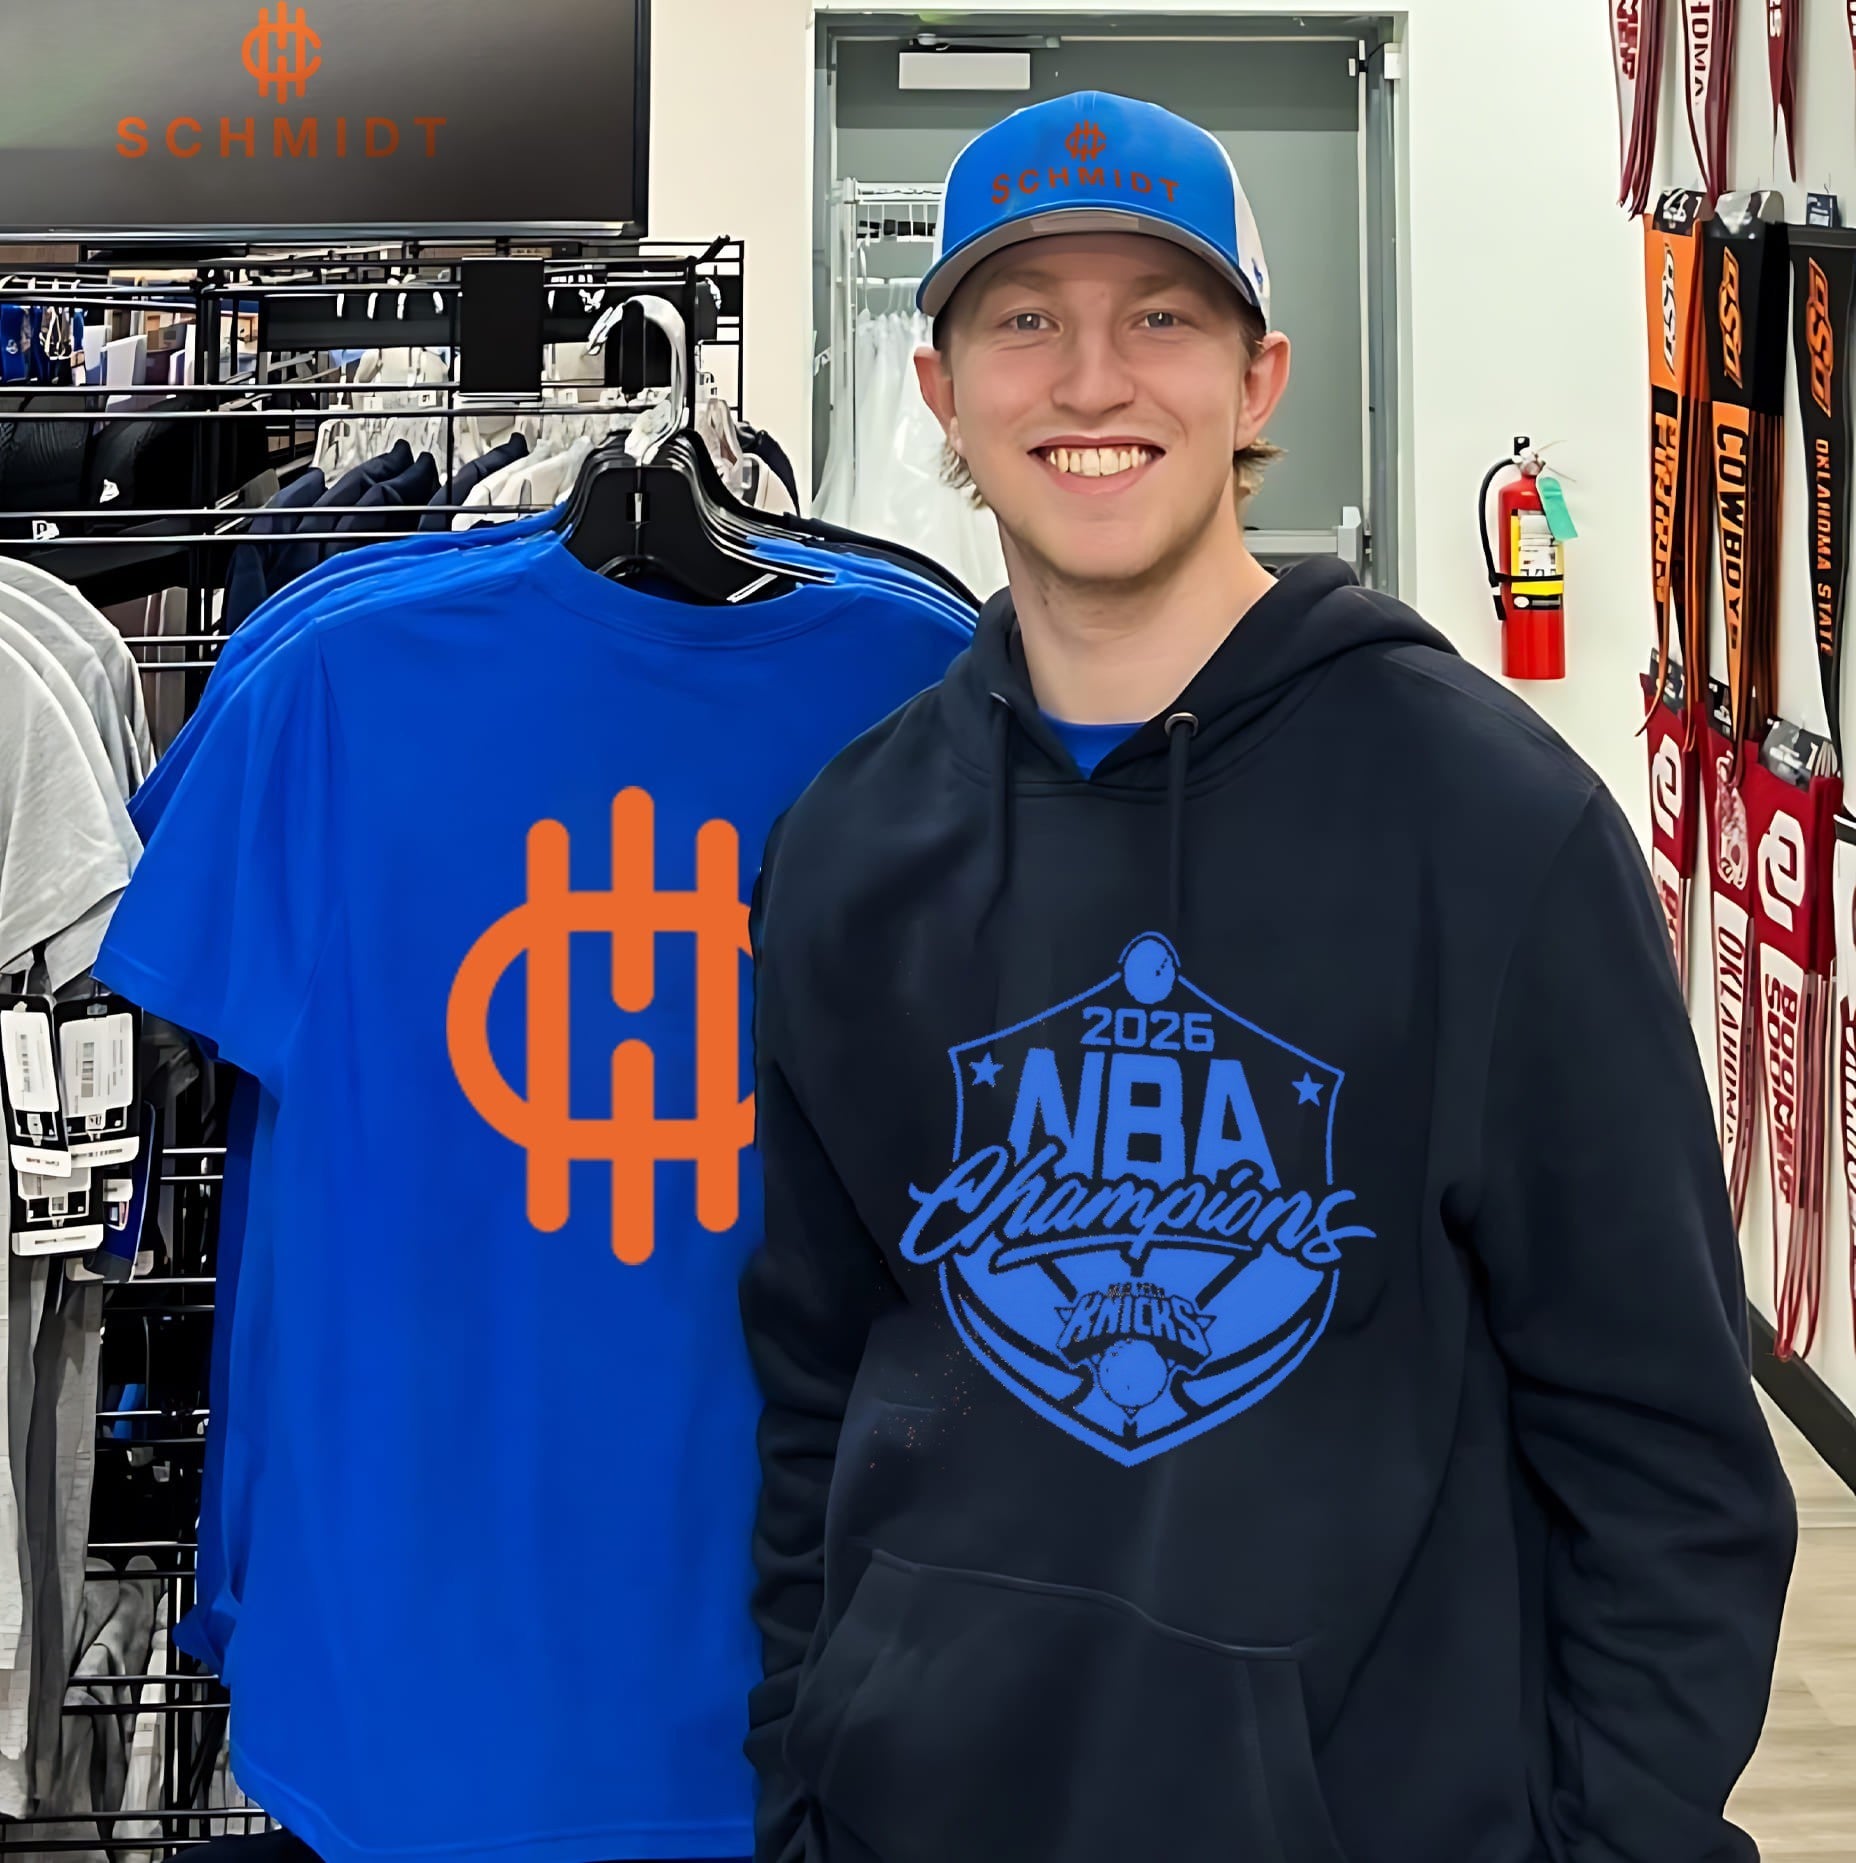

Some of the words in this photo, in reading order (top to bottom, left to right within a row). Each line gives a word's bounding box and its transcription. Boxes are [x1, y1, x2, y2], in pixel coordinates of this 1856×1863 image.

[115, 116, 448, 159] SCHMIDT
[991, 166, 1179, 205] SCHMIDT
[1080, 1006, 1215, 1053] 2026
[1007, 1047, 1282, 1192] NBA
[899, 1144, 1377, 1265] Champions
[1057, 1293, 1211, 1358] KNICKS
